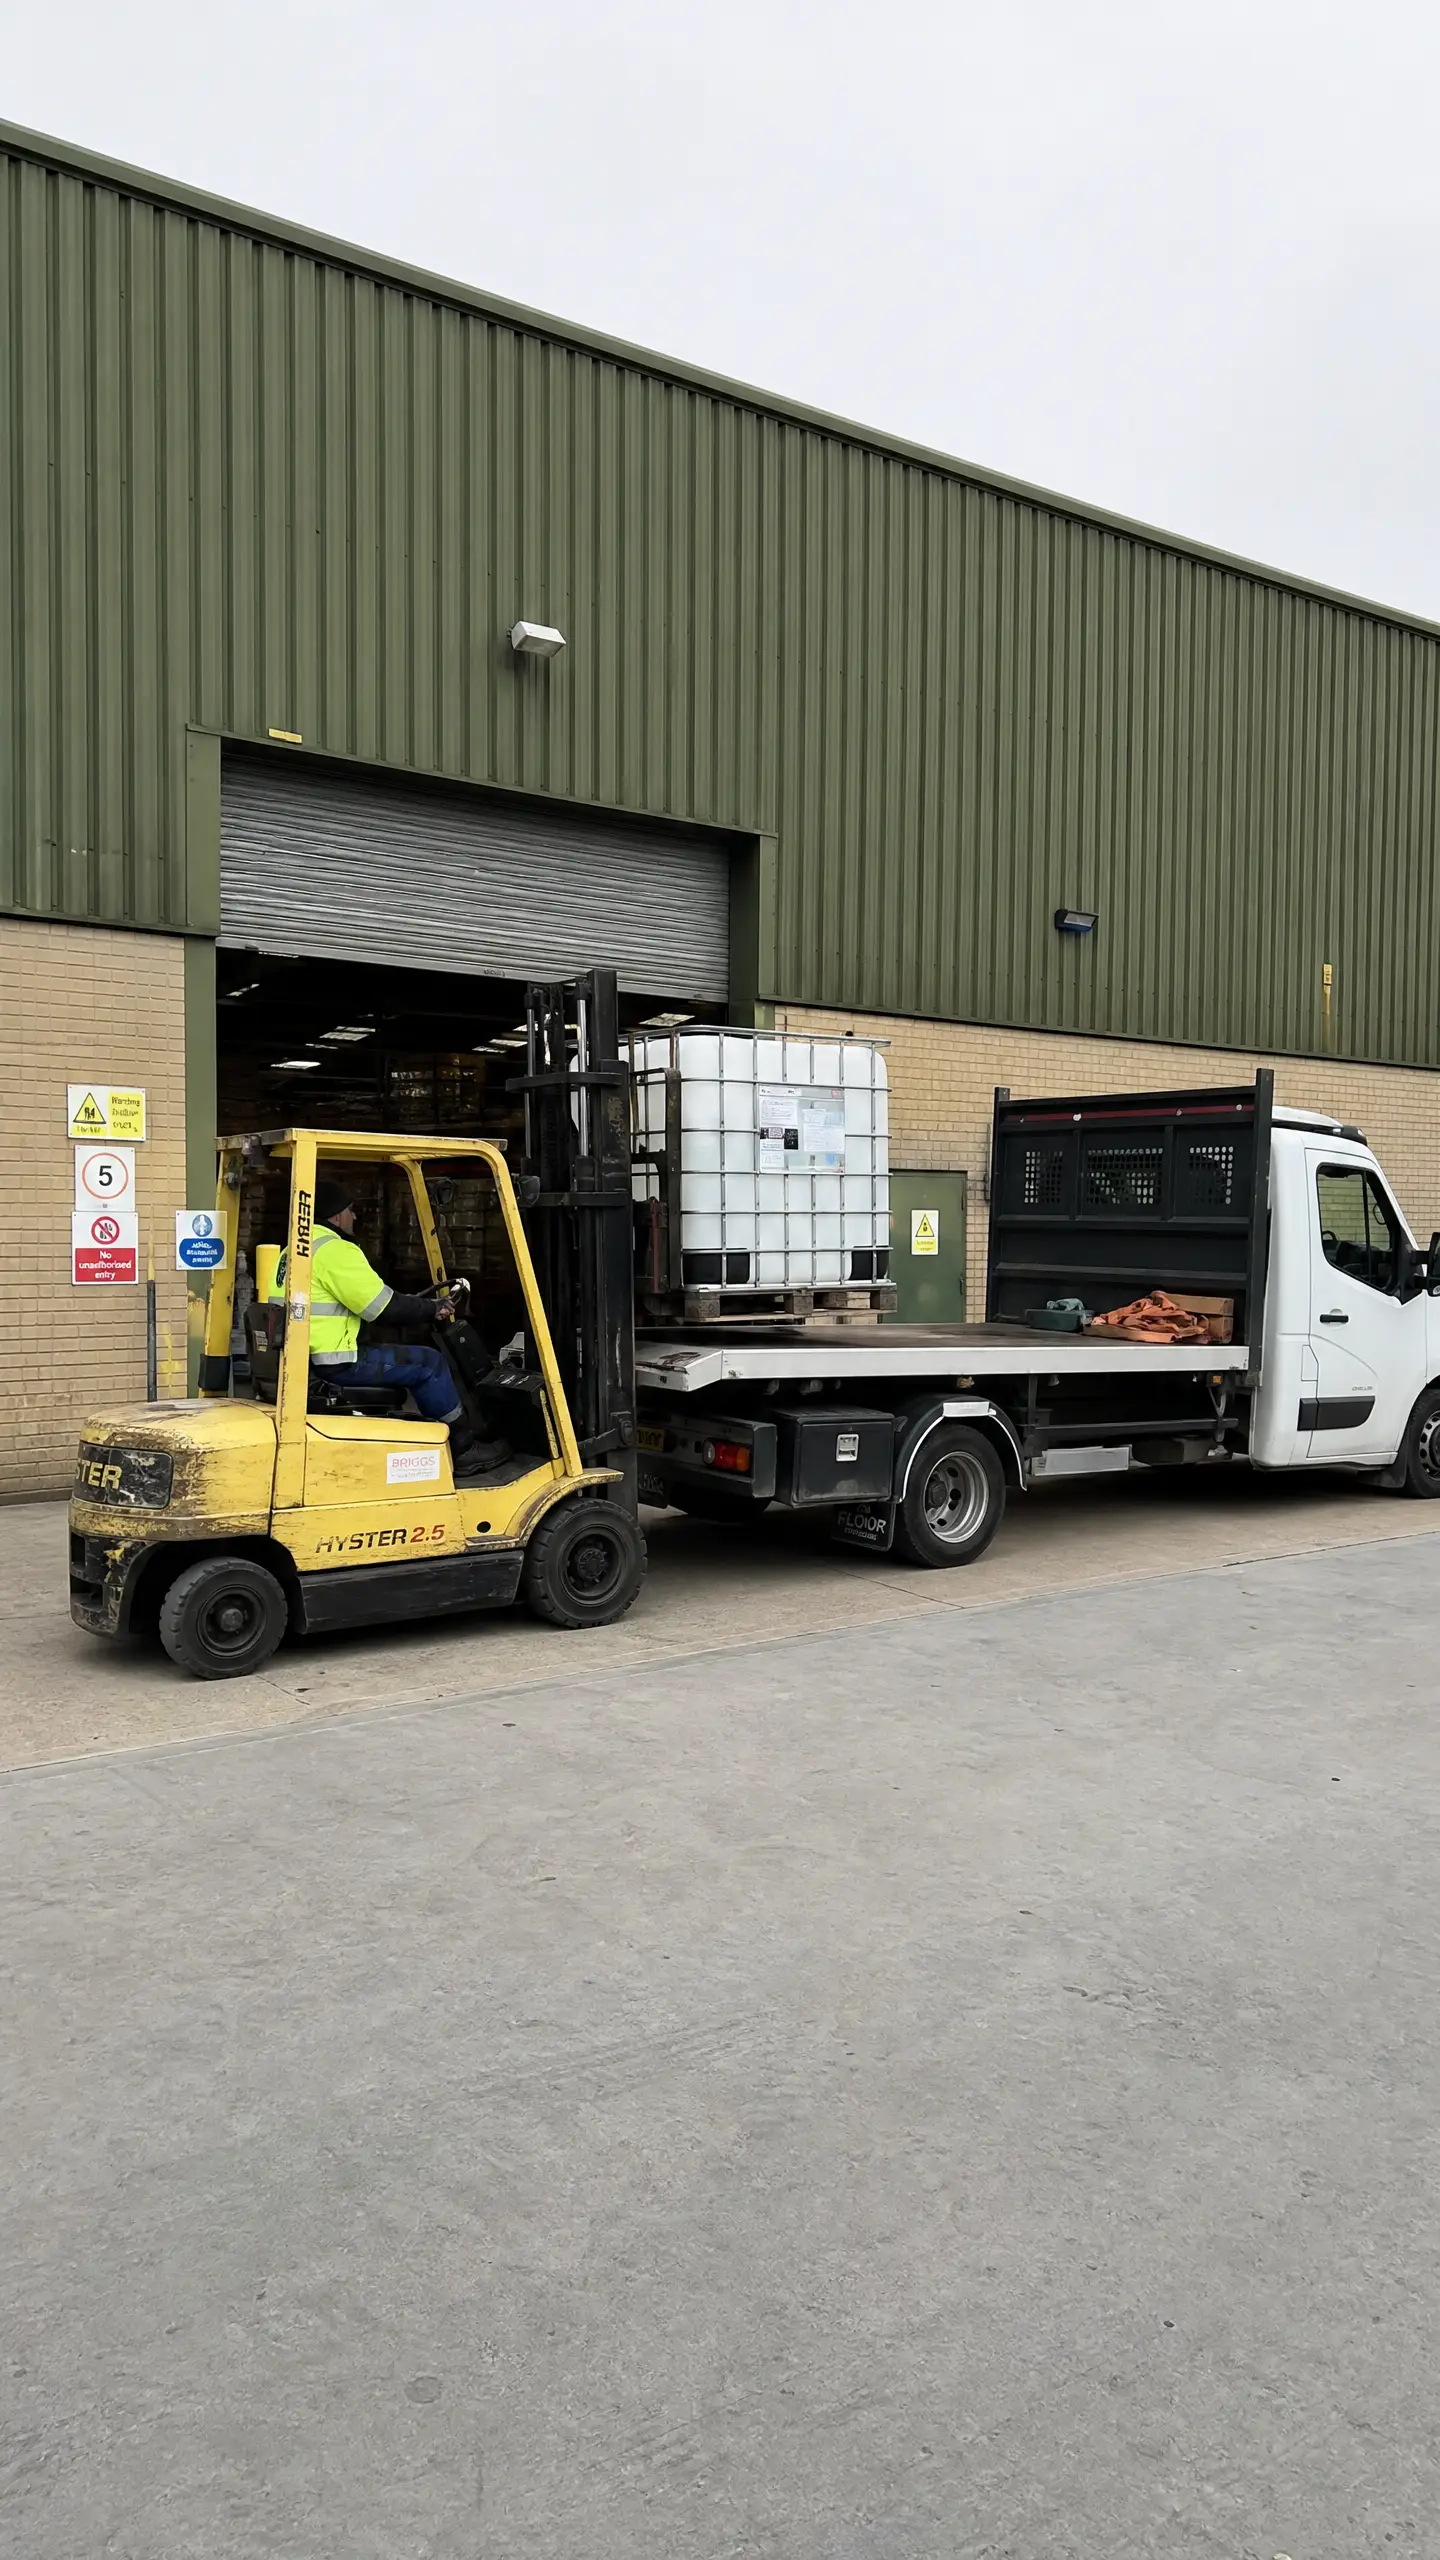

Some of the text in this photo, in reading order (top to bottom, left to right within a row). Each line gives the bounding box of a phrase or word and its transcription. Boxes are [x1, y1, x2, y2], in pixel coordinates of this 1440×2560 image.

[98, 1165, 113, 1187] 5
[99, 1250, 112, 1260] No
[94, 1270, 116, 1281] entry
[391, 1456, 436, 1468] BRIGGS
[315, 1524, 446, 1553] HYSTER 2.5
